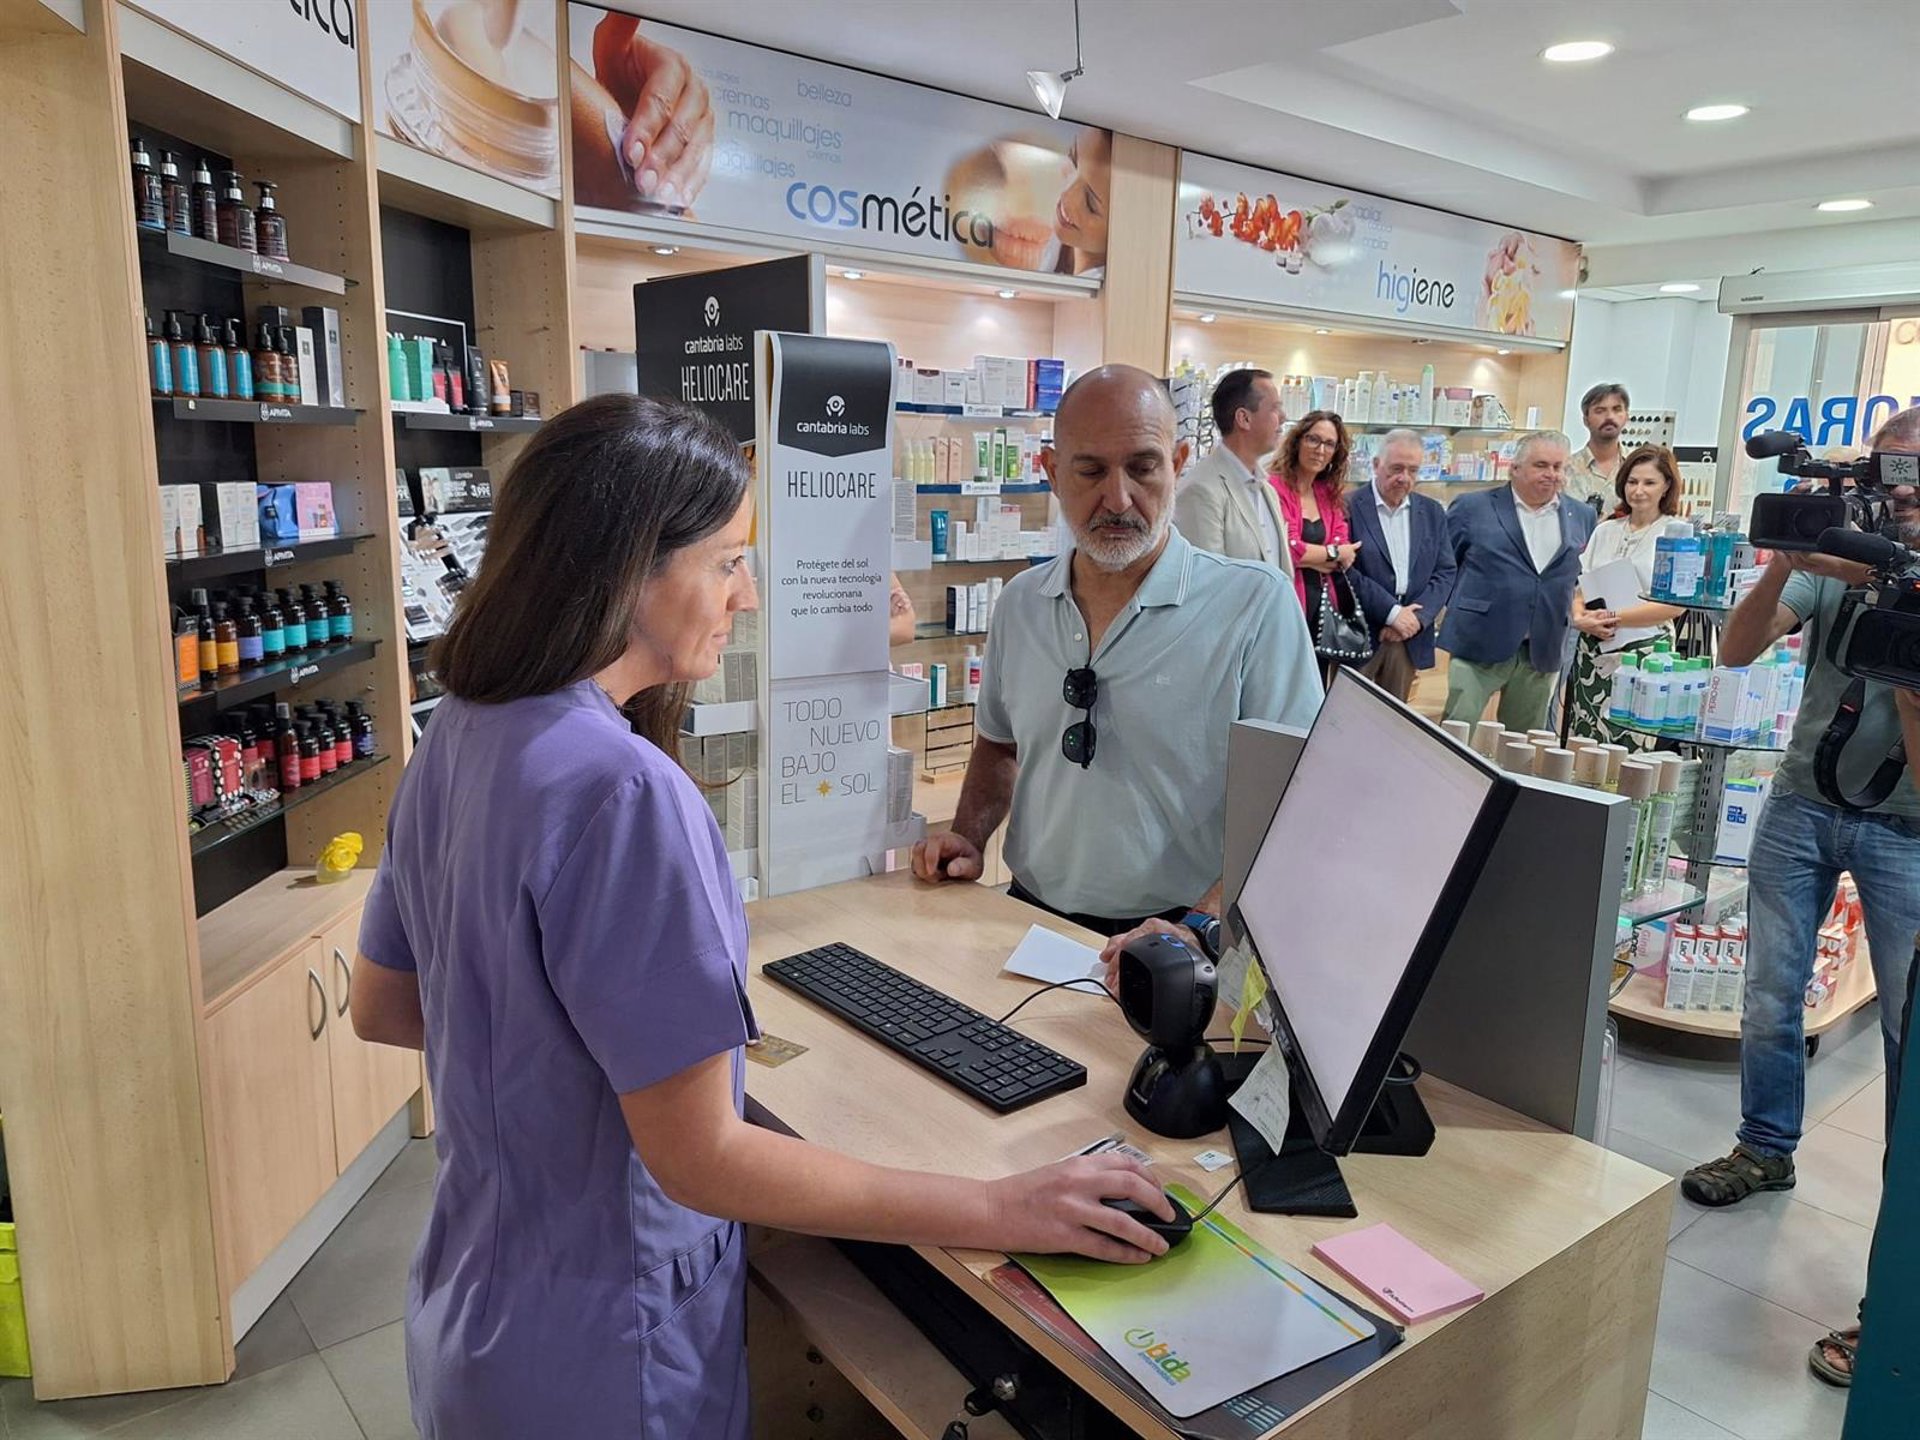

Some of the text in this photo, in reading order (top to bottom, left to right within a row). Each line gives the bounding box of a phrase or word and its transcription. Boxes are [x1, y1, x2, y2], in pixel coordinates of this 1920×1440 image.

[797, 79, 852, 107] belleza
[728, 110, 842, 150] maquillajes
[786, 182, 995, 250] cosmética
[1376, 260, 1455, 313] higiene
[684, 333, 743, 354] cantabria labs
[681, 363, 750, 402] HELIOCARE
[796, 421, 870, 436] cantabria labs
[787, 470, 877, 499] HELIOCARE
[796, 558, 869, 571] Protégete del sol
[781, 573, 882, 585] con la nueva tecnología
[802, 590, 863, 600] revolucionaria
[790, 602, 873, 618] que lo cambia todo
[783, 697, 842, 722] TODO
[810, 719, 880, 748] NUEVO
[781, 751, 836, 778] BAJO
[781, 772, 878, 804] EL SOL
[1630, 925, 1641, 958] Lacer
